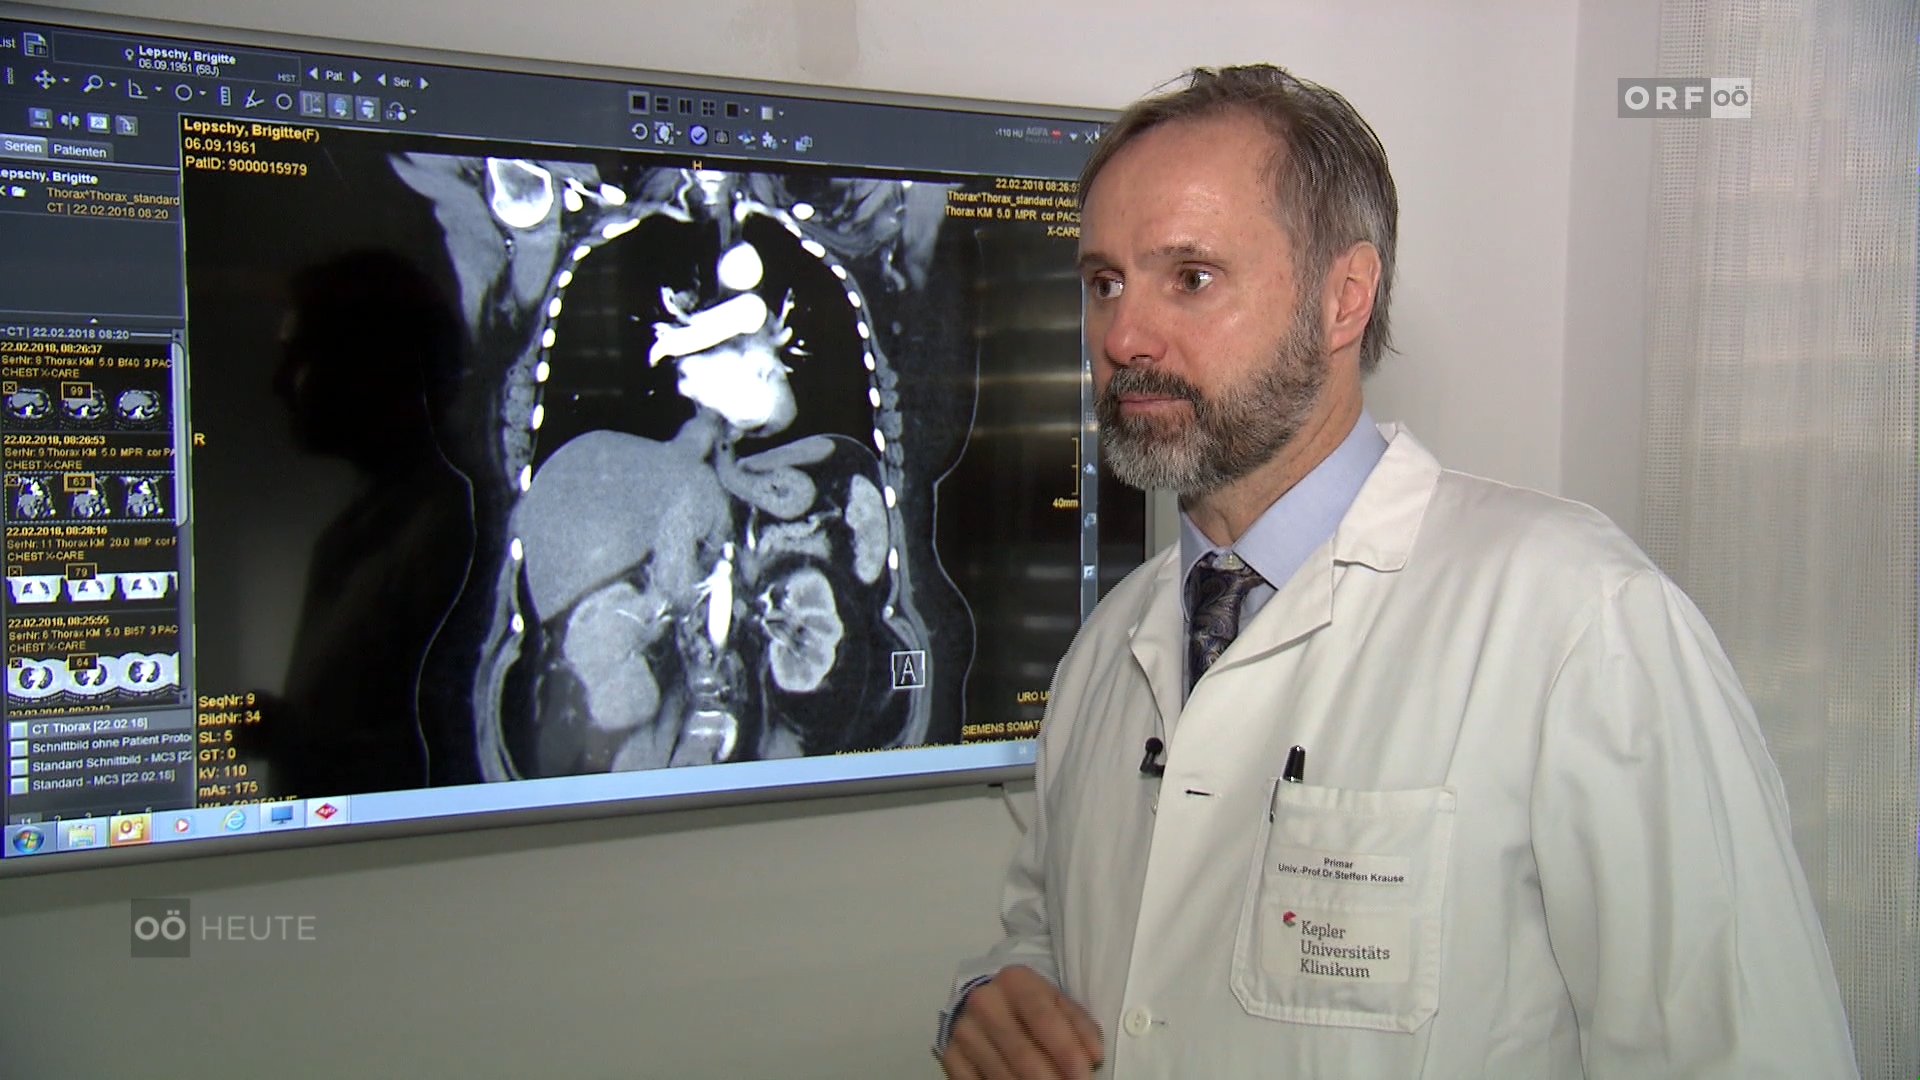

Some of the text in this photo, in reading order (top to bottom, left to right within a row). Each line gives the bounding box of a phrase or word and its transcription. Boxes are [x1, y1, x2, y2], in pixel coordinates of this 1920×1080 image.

[193, 50, 236, 65] Brigitte
[138, 58, 192, 73] 06.09.1961
[183, 118, 320, 143] Lepschy, Brigitte(F)
[4, 140, 42, 153] Serien
[53, 144, 107, 158] Patienten
[184, 137, 256, 154] 06.09.1961
[185, 155, 308, 176] PatID: 9000015979
[692, 160, 703, 170] H
[0, 168, 98, 185] epschy, Brigitte
[995, 178, 1043, 191] 22.02.2018
[47, 202, 63, 213] CT
[945, 205, 975, 218] Thorax
[977, 207, 993, 218] KM
[1014, 210, 1037, 220] MPR
[1041, 212, 1055, 222] cor
[7, 326, 24, 337] CT
[33, 328, 95, 338] 22.02.2018
[99, 330, 129, 340] 08:20
[45, 356, 78, 366] Thorax
[79, 357, 94, 367] KM
[2, 368, 38, 378] CHEST
[194, 432, 206, 445] R
[48, 447, 80, 457] Thorax
[82, 448, 97, 457] KM
[120, 448, 143, 458] MPR
[147, 449, 161, 457] cor
[5, 460, 41, 470] CHEST
[1052, 498, 1078, 508] 40mm
[56, 539, 88, 549] Thorax
[90, 538, 105, 548] KM
[7, 552, 44, 562] CHEST
[51, 629, 84, 640] Thorax
[86, 628, 101, 638] KM
[9, 643, 46, 654] CHEST
[900, 655, 917, 684] A
[199, 693, 255, 709] SeqNr: 9
[1017, 691, 1039, 702] URO
[199, 710, 261, 726] BildNr: 34
[33, 724, 49, 735] CT
[53, 720, 91, 733] Thorax
[962, 722, 1005, 735] SIEMENS
[200, 729, 232, 743] SL: 5
[33, 740, 89, 753] Schnittbild
[92, 737, 119, 749] ohne
[122, 734, 160, 747] Patient
[33, 759, 83, 772] Standard
[86, 754, 141, 768] Schnittbild
[151, 752, 176, 763] MC3
[200, 749, 224, 761] GT:
[224, 764, 247, 776] 110
[33, 777, 83, 791] Standard
[94, 774, 118, 786] MC3
[199, 781, 258, 797] mAs: 175
[1324, 857, 1353, 869] Primar
[1370, 872, 1404, 883] Krause
[1301, 919, 1346, 940] Kepler
[1300, 939, 1390, 960] Universitäts
[1300, 958, 1370, 978] Klinikum
